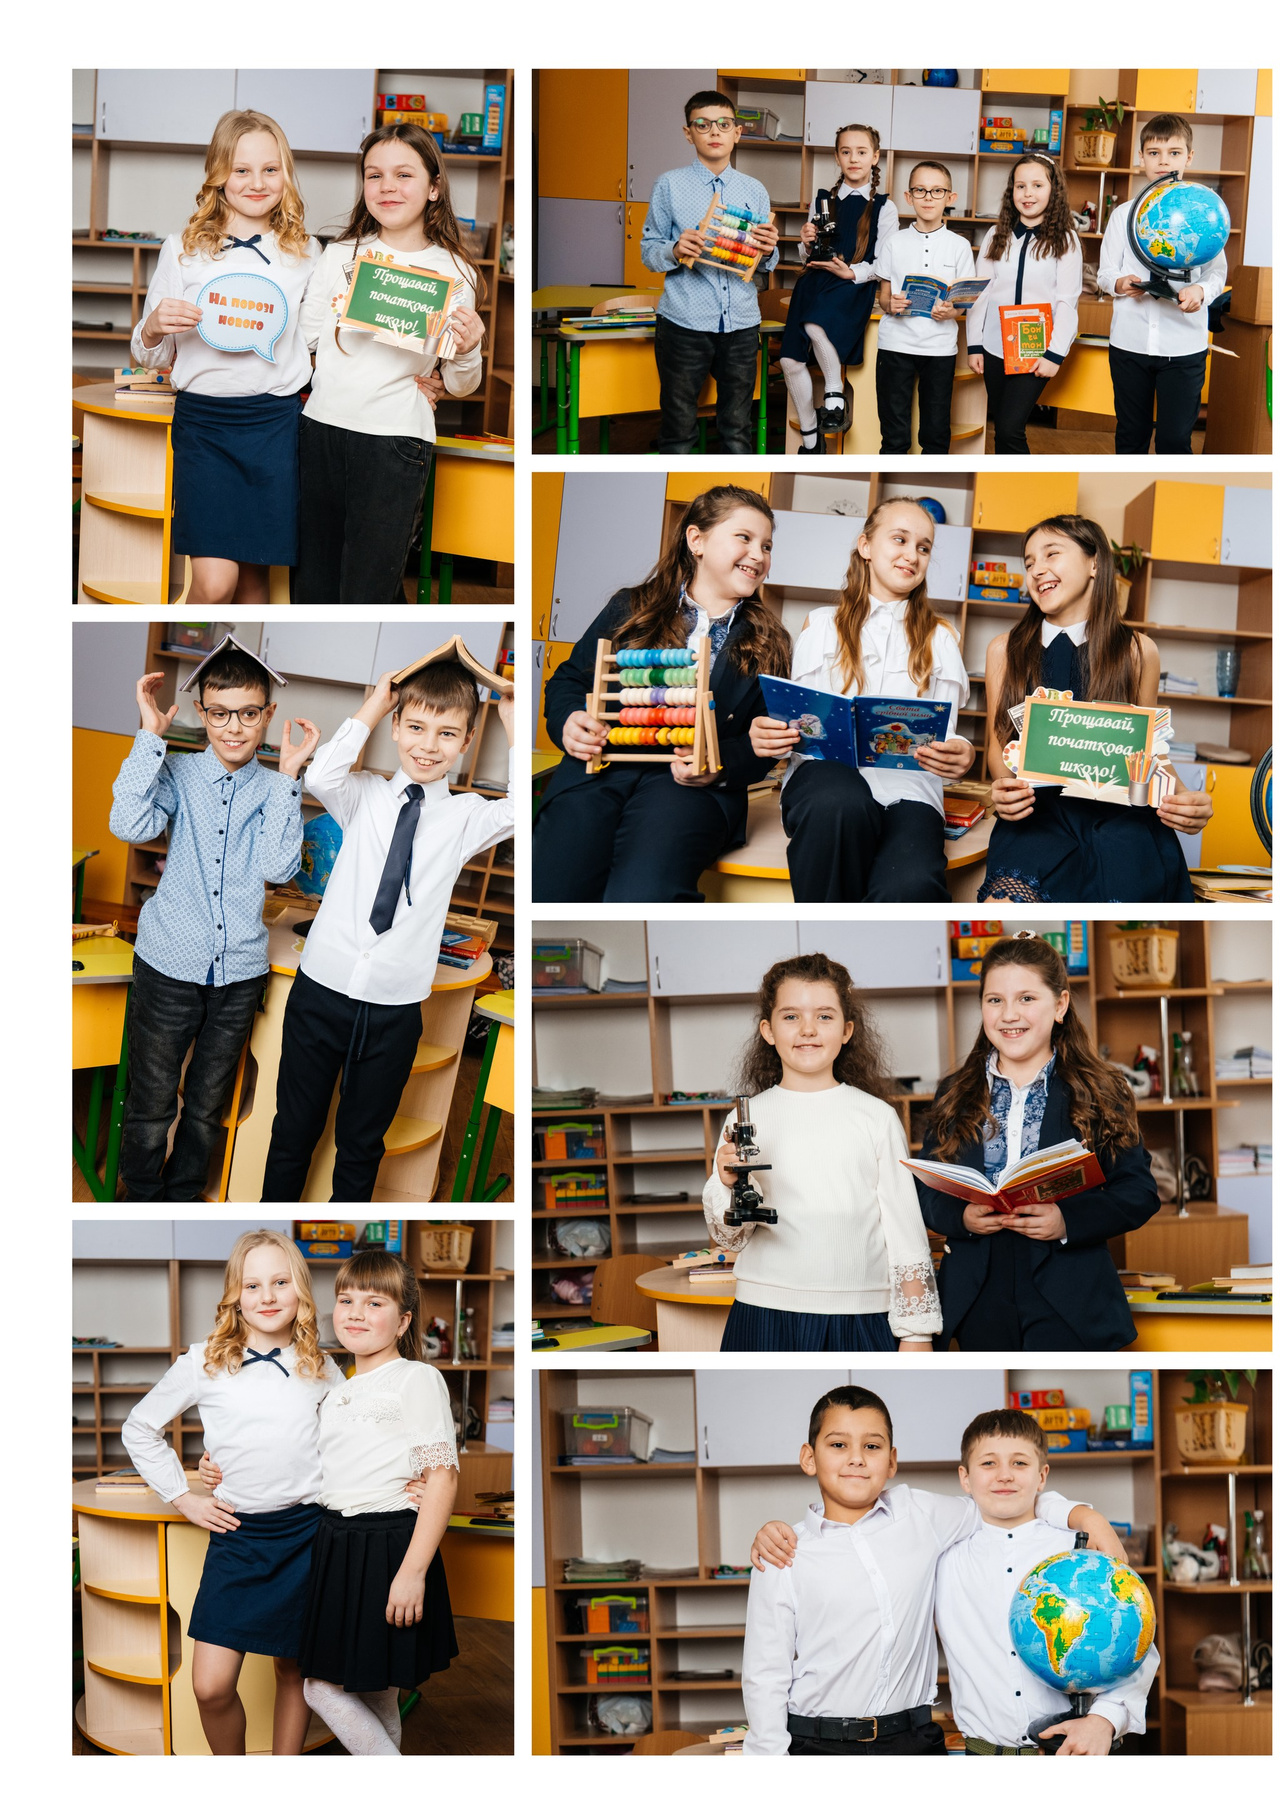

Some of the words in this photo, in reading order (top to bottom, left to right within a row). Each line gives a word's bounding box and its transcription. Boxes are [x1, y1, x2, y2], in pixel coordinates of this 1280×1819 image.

[373, 267, 438, 296] Прощавай,
[369, 290, 434, 314] початкова
[1034, 687, 1073, 700] ABC
[1048, 708, 1135, 734] Прощавай,
[1048, 735, 1133, 757] початкова
